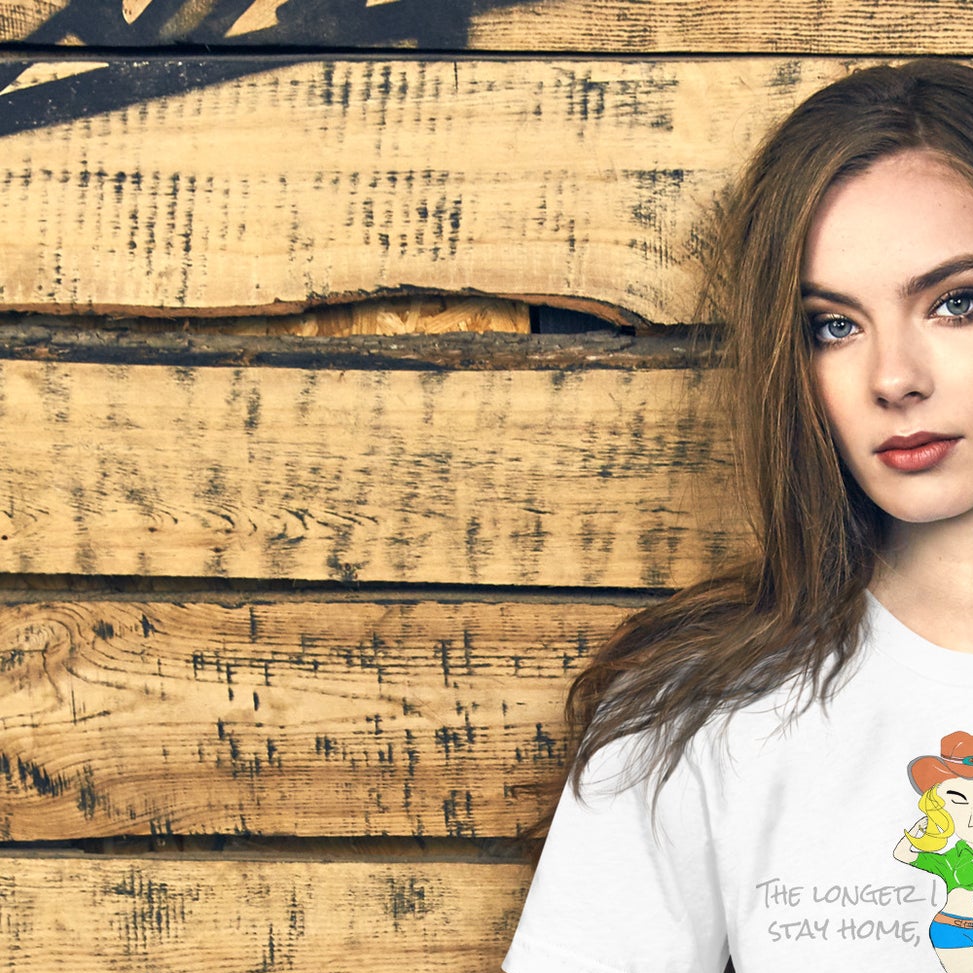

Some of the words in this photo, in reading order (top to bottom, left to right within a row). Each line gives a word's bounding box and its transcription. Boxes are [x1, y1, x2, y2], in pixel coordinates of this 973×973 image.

[755, 877, 804, 909] THE
[813, 883, 928, 908] LONGER
[931, 879, 938, 908] I
[768, 918, 830, 943] STAY
[836, 918, 921, 948] HOME,
